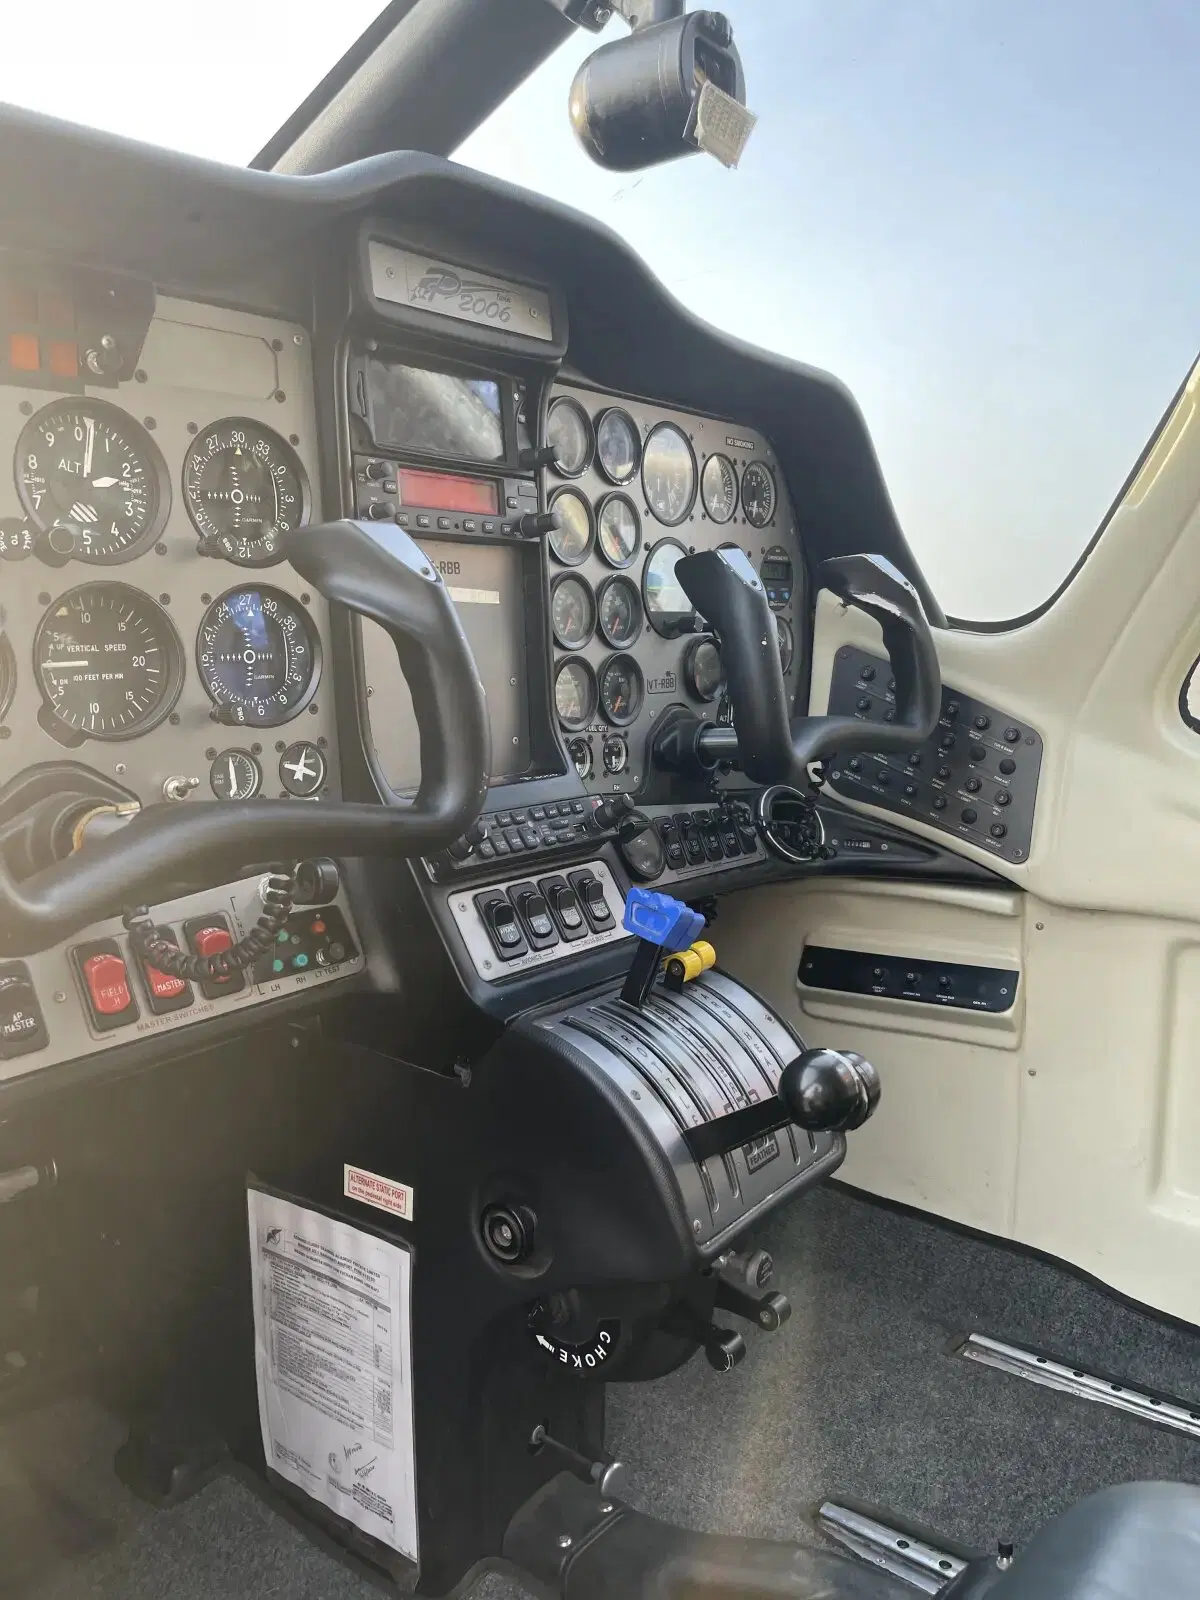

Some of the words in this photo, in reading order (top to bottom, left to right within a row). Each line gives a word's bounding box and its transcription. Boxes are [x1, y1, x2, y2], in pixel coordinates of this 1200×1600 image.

[459, 293, 512, 323] 2006
[45, 432, 55, 447] 9
[206, 434, 220, 450] 27
[231, 431, 245, 443] 30
[726, 438, 734, 446] NO
[734, 440, 754, 450] SMOKING
[256, 440, 270, 455] 33
[28, 454, 38, 469] 8
[58, 458, 82, 474] ALT
[191, 454, 203, 471] 24
[122, 463, 131, 478] 2
[32, 494, 41, 510] 7
[285, 494, 295, 503] 3
[125, 501, 133, 516] 3
[110, 522, 119, 537] 4
[10, 534, 19, 546] TO
[21, 530, 32, 550] PULL
[82, 530, 92, 545] 5
[238, 547, 252, 558] 12
[431, 560, 461, 575] -RBB
[239, 594, 253, 606] 27
[263, 598, 278, 612] 30
[81, 612, 91, 623] 10
[215, 602, 229, 618] 24
[117, 622, 127, 632] 15
[283, 615, 297, 631] 33
[66, 643, 100, 653] VERTICAL
[104, 643, 127, 652] SPEED
[132, 655, 146, 667] 20
[84, 673, 100, 681] FEET
[648, 678, 674, 690] VT-RBB
[58, 686, 65, 696] 5
[125, 690, 135, 700] 15
[89, 702, 100, 714] 10
[520, 953, 543, 965] AVIONICS
[314, 969, 324, 979] LT
[325, 965, 341, 976] TEST
[155, 977, 185, 993] MASTER
[295, 975, 307, 985] RH
[100, 985, 124, 1000] FIELD
[270, 983, 281, 993] LH
[12, 1011, 23, 1023] AP
[136, 1013, 174, 1032] MASTER
[4, 1017, 36, 1034] MASTER
[742, 1030, 778, 1078] HEAT
[750, 1143, 775, 1165] FEATHER
[350, 1173, 376, 1191] ALTERNATE
[376, 1183, 391, 1197] STATIC
[391, 1189, 404, 1201] PORT
[357, 1187, 365, 1195] the
[559, 1331, 611, 1368] CHOKE
